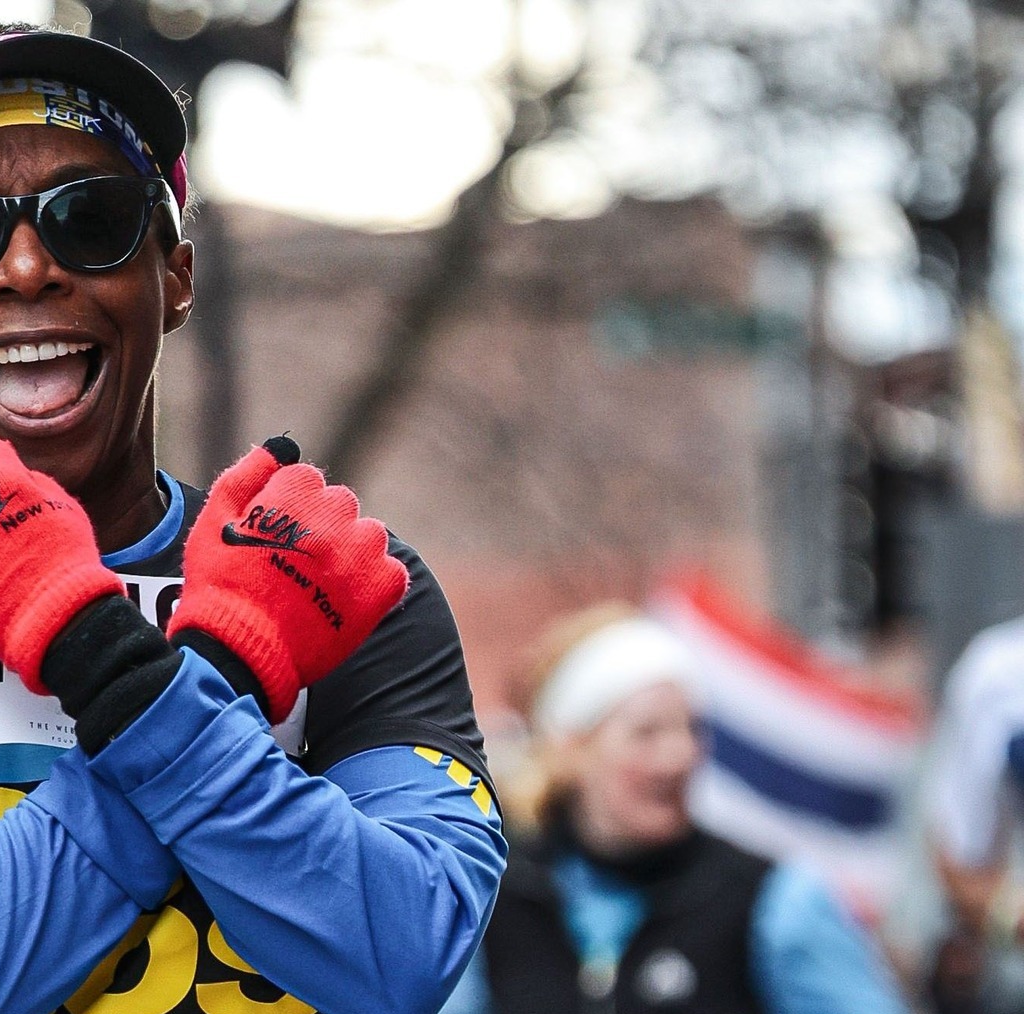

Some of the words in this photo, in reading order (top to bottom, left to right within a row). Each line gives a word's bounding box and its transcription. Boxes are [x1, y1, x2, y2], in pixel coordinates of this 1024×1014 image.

[0, 503, 42, 533] New
[240, 505, 311, 548] RUN
[270, 551, 312, 588] New
[312, 586, 343, 631] York
[29, 721, 49, 731] THE
[56, 724, 75, 735] WEB
